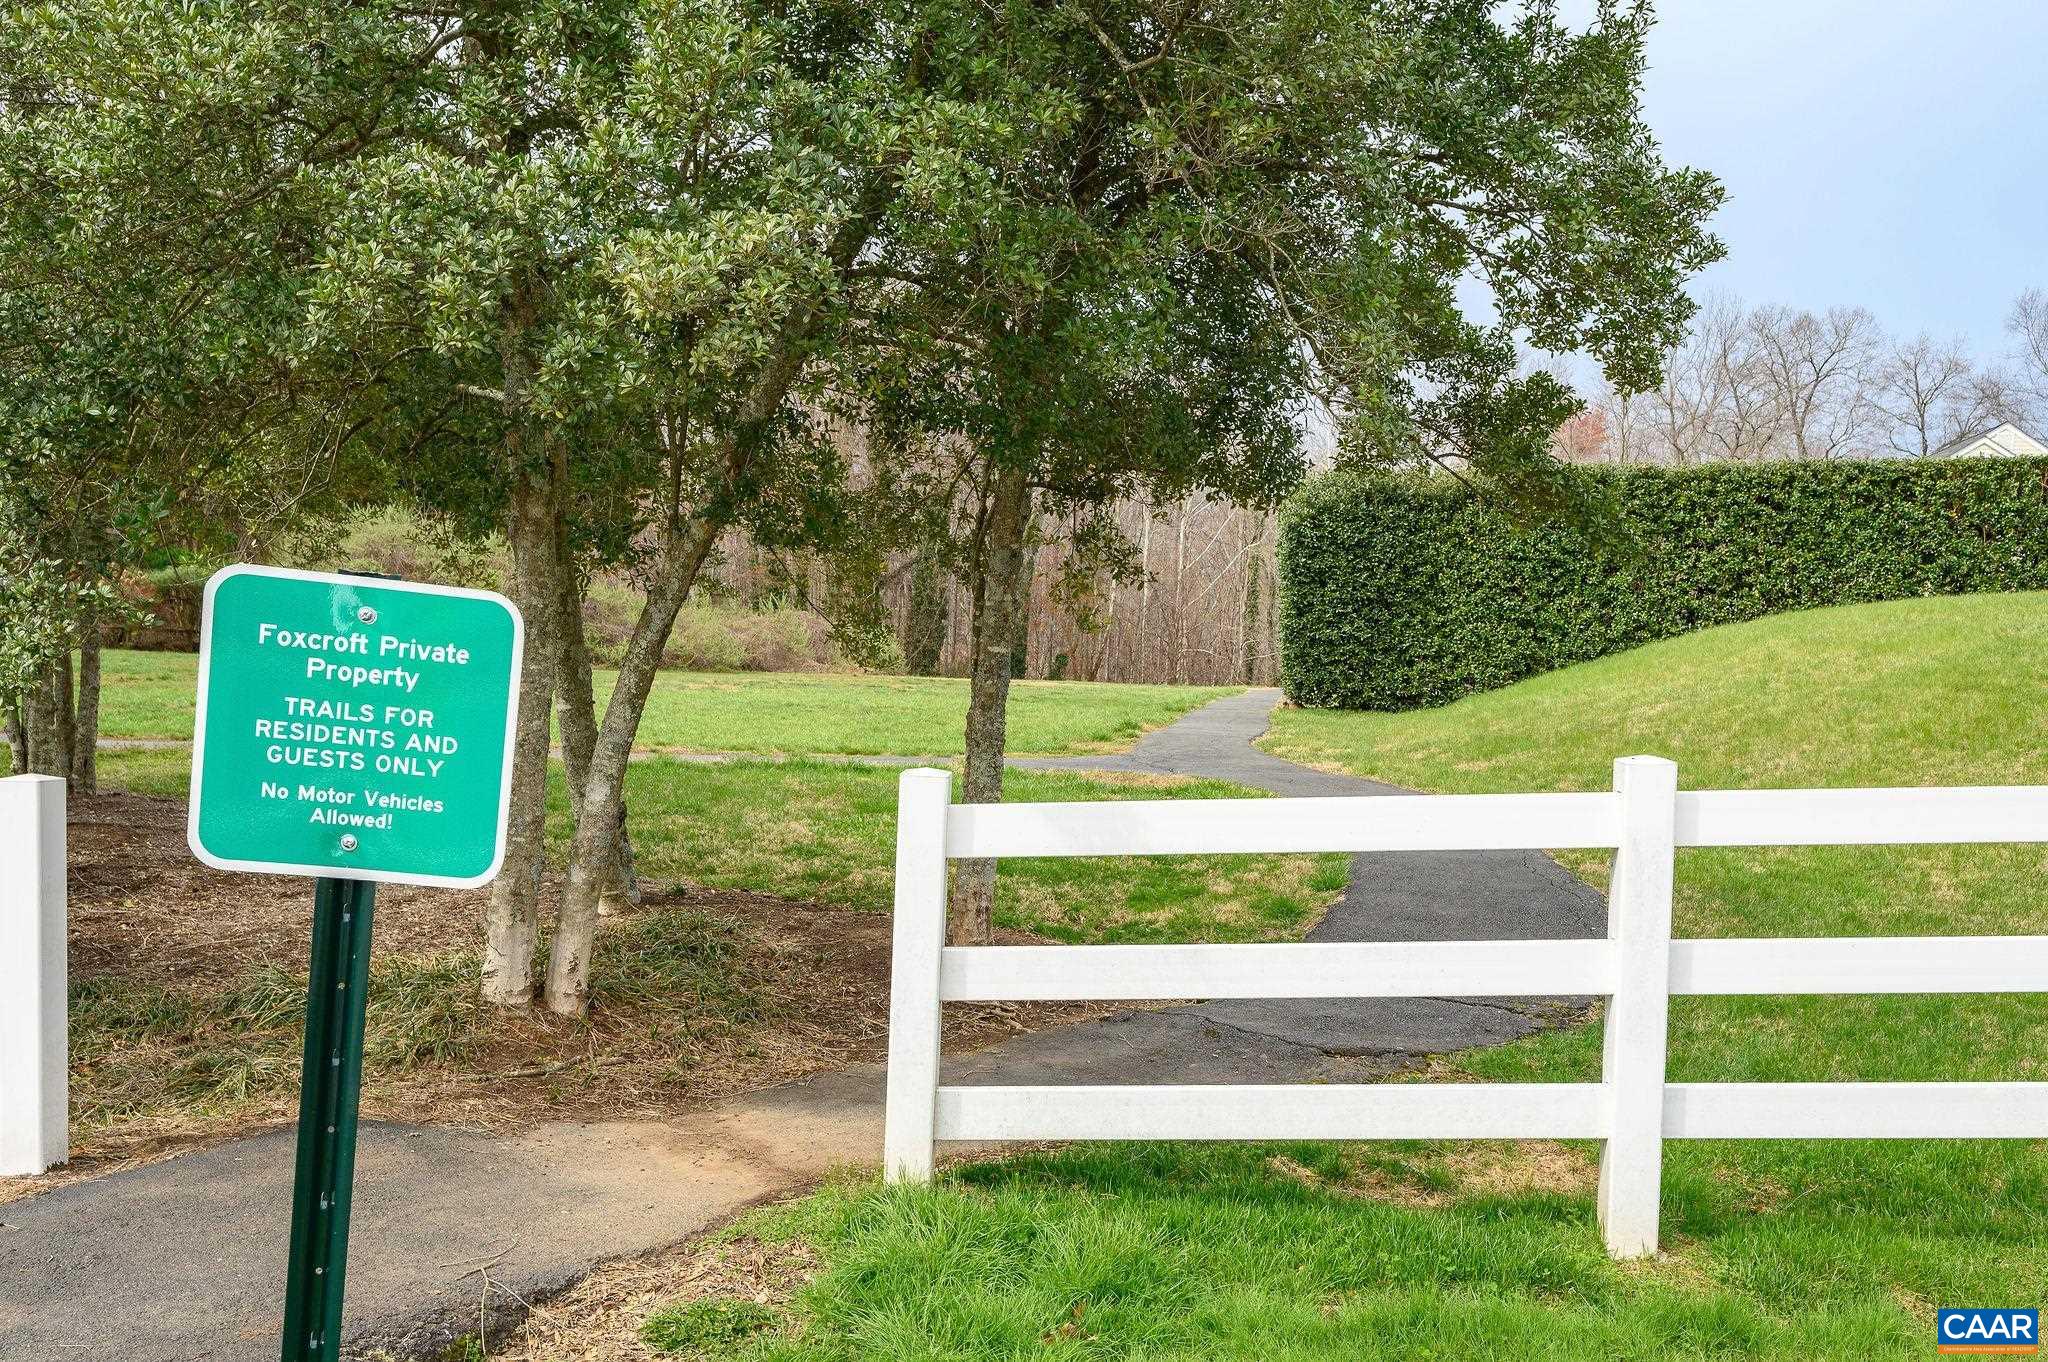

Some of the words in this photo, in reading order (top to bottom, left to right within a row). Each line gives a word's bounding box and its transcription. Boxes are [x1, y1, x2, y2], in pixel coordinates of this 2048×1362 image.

[258, 623, 368, 654] Foxcroft
[379, 635, 469, 665] Private
[306, 658, 420, 693] Property
[285, 697, 375, 723] TRAILS
[384, 707, 434, 728] FOR
[255, 719, 396, 749] RESIDENTS
[404, 733, 458, 754] AND
[266, 745, 365, 770] GUESTS
[375, 754, 445, 778] ONLY
[260, 782, 289, 800] No
[298, 785, 355, 804] Motor
[364, 790, 444, 813] Vehicles
[309, 808, 393, 830] Allowed!
